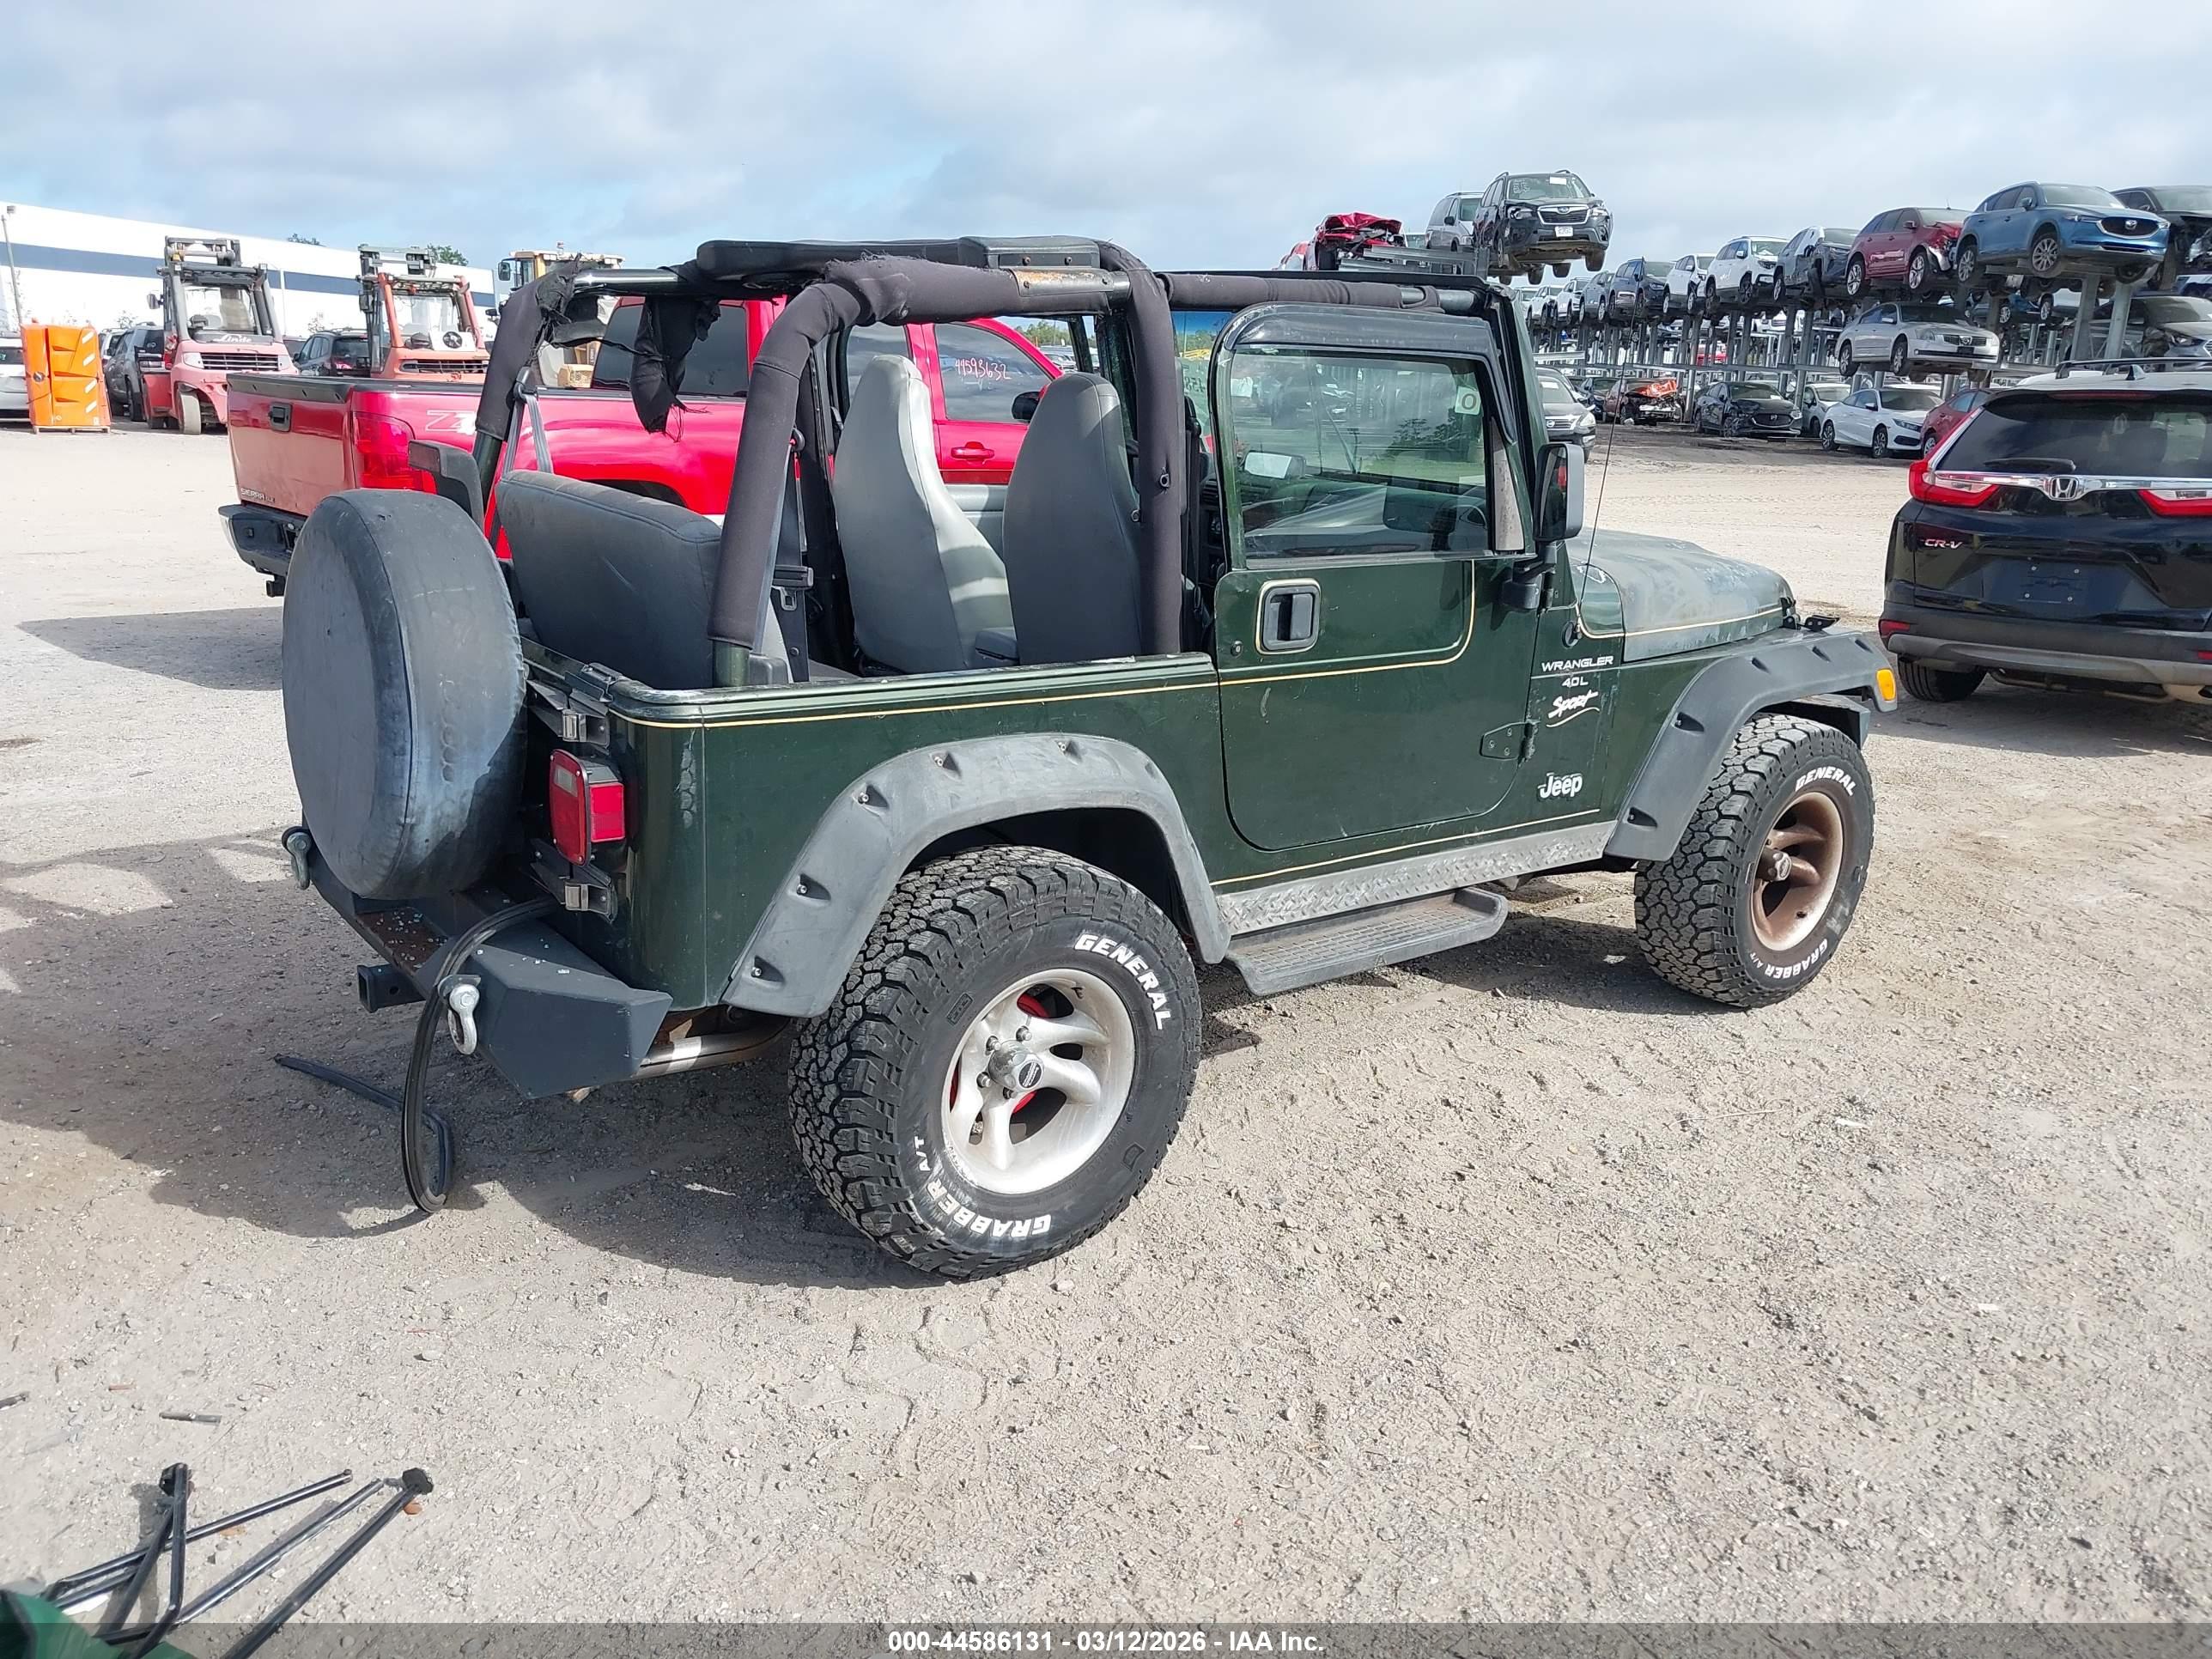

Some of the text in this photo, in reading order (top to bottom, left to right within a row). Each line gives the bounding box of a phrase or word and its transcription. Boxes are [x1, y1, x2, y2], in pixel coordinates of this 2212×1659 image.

[213, 333, 252, 343] Linde
[1924, 538, 1964, 549] CR-V
[1541, 655, 1614, 672] WRANGLER
[1547, 690, 1599, 719] Sport
[1537, 772, 1583, 799] Jeep
[1795, 766, 1856, 797] GENERAL
[1764, 938, 1828, 980] GRABBER
[1074, 933, 1171, 1030] GENERAL
[914, 1135, 1052, 1238] GRABBER A/T
